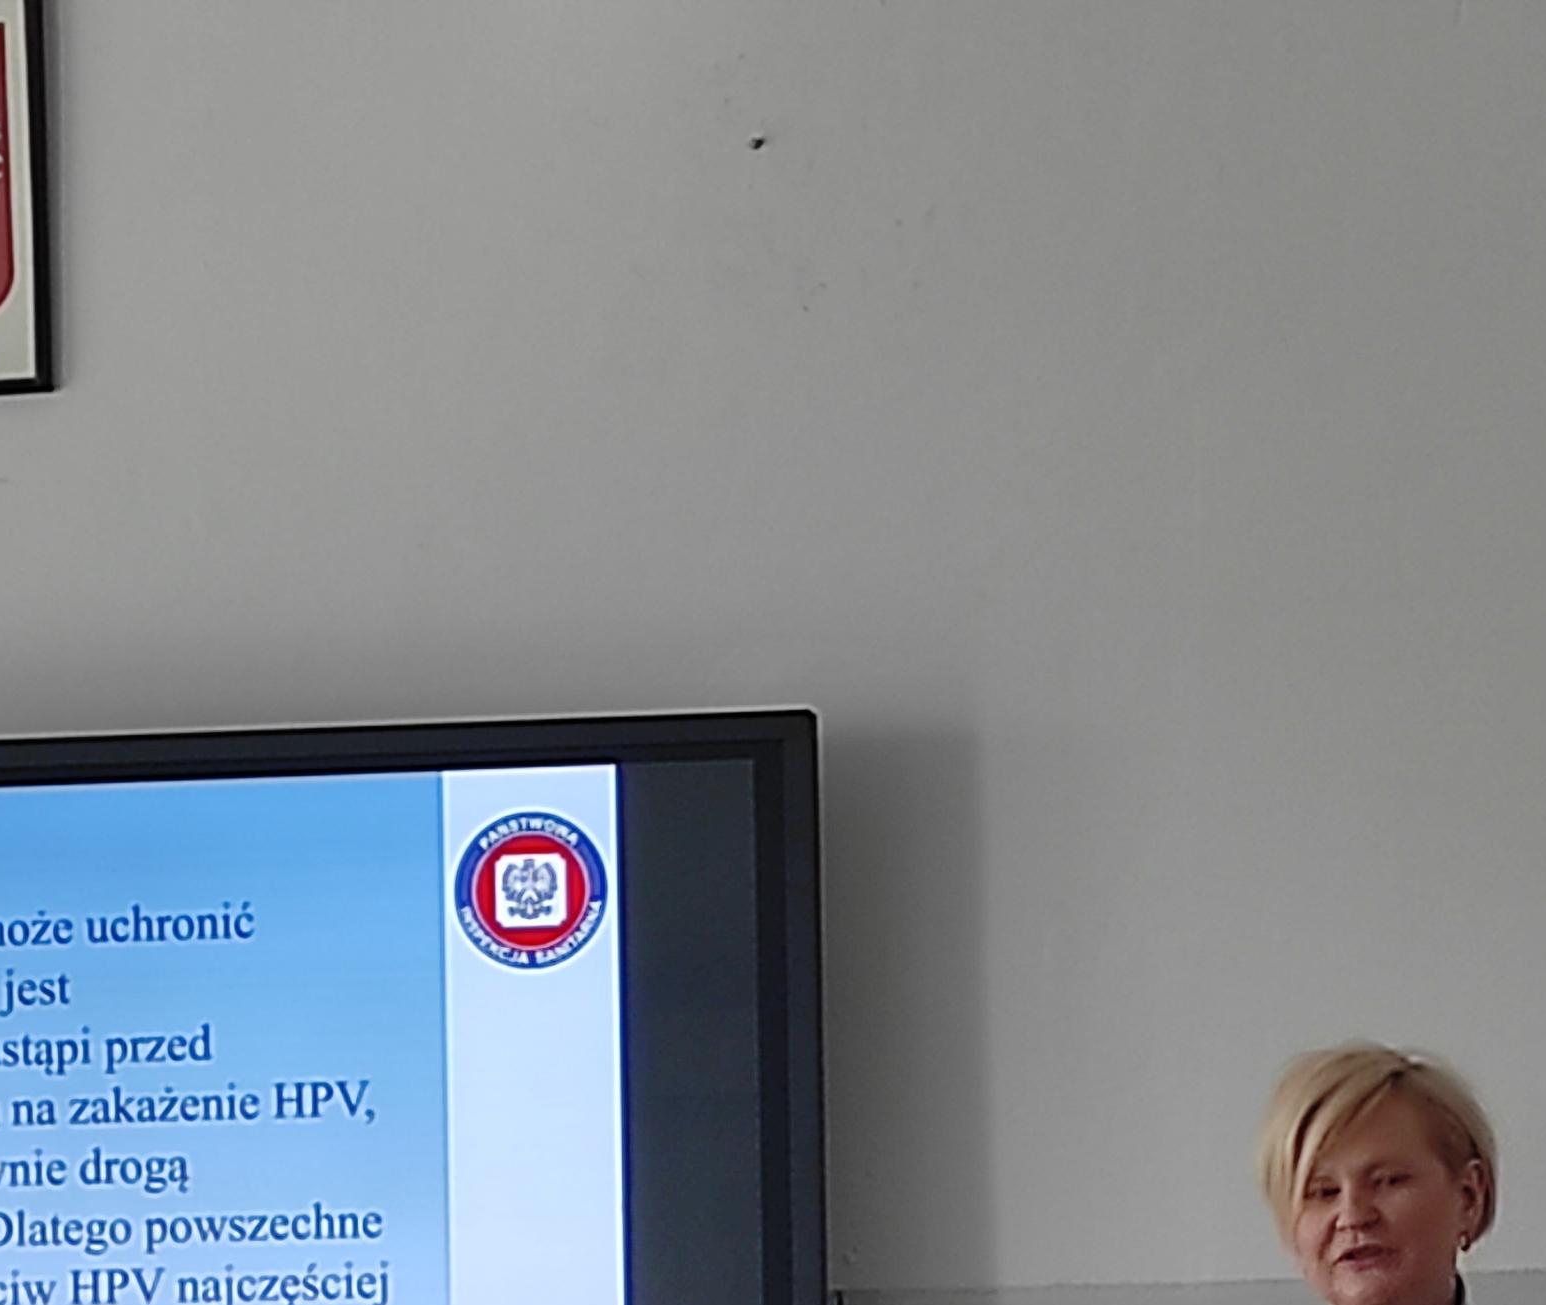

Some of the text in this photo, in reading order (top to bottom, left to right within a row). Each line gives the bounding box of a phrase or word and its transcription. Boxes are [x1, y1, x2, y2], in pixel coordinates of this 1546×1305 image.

[85, 900, 255, 945] uchronić
[103, 1021, 214, 1076] przed
[10, 1098, 58, 1128] na
[67, 1080, 261, 1126] zakażenie
[273, 1078, 377, 1126] HPV,
[78, 1145, 191, 1195] drogą
[144, 1200, 384, 1256] powszechne
